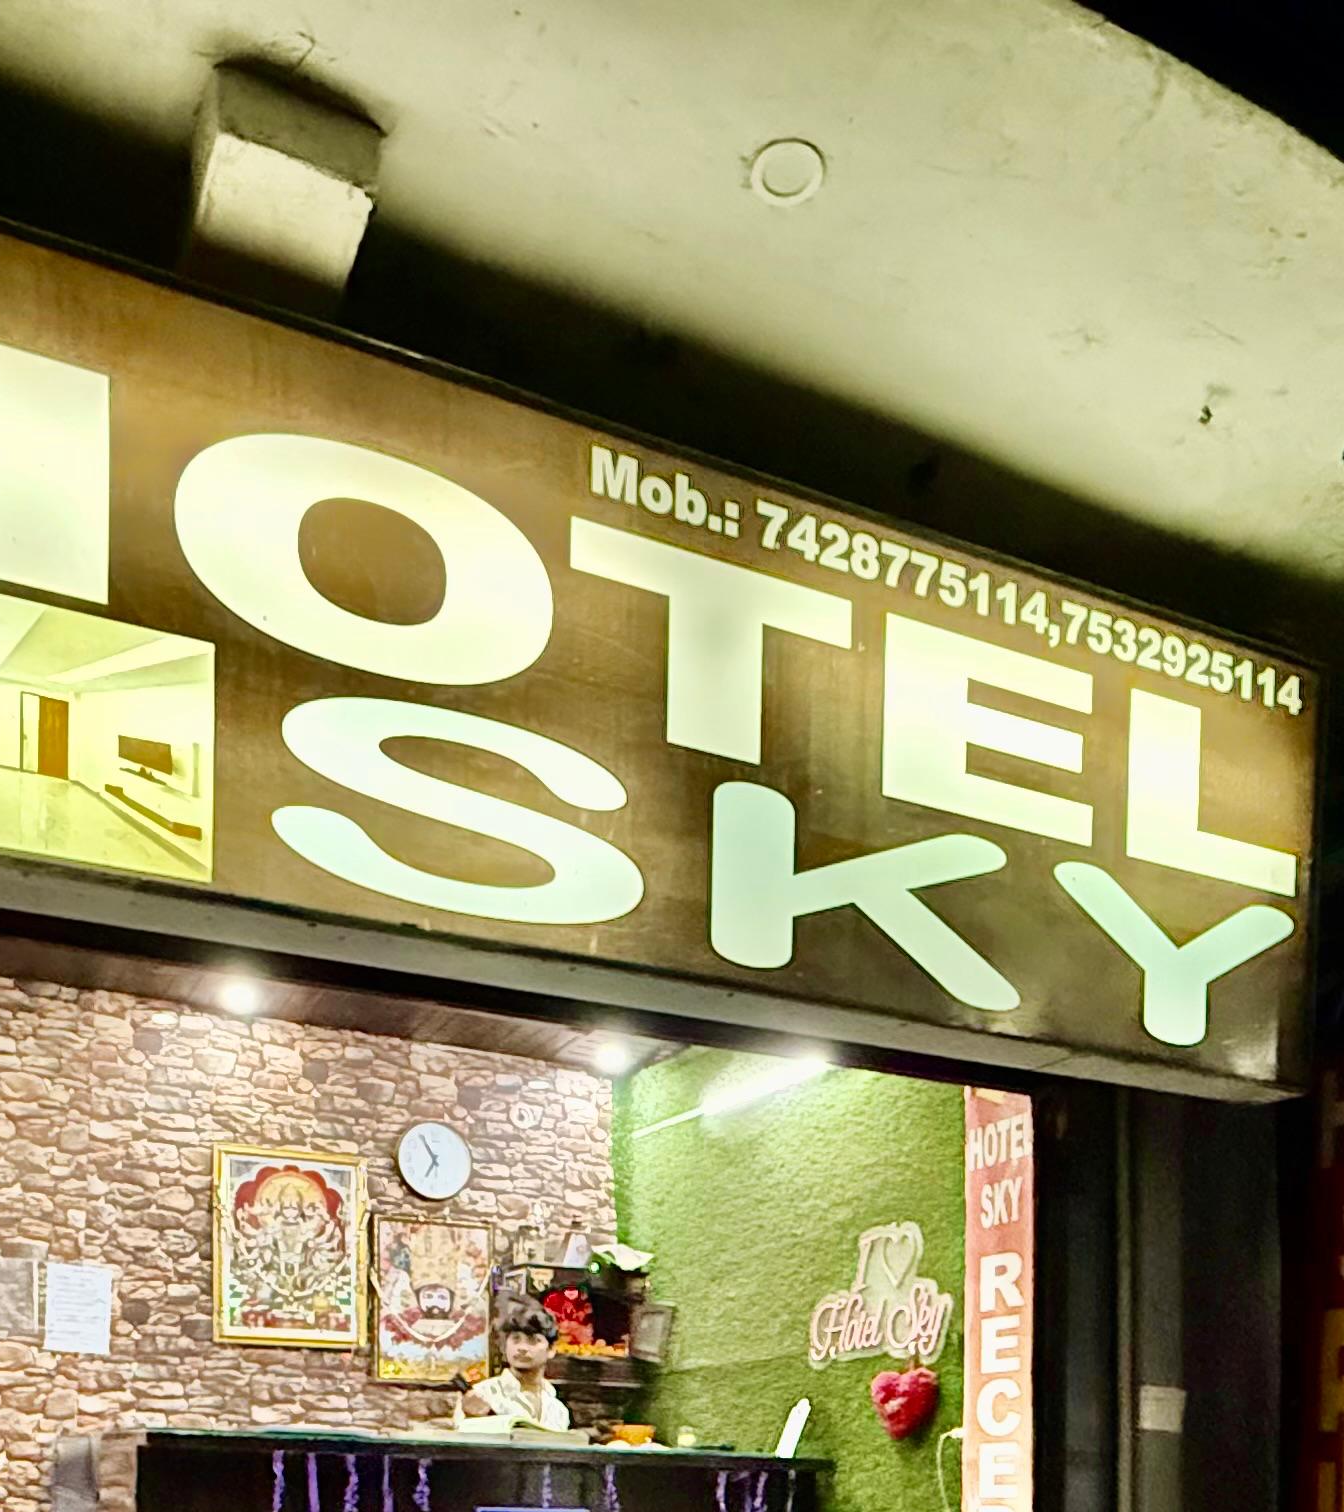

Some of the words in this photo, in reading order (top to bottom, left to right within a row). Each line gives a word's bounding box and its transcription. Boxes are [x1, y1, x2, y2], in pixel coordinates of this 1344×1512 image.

[589, 444, 740, 537] Mob.:
[756, 500, 1304, 716] 7428775114,7532925114
[270, 697, 1296, 1047] SKY
[980, 1176, 1024, 1230] SKY
